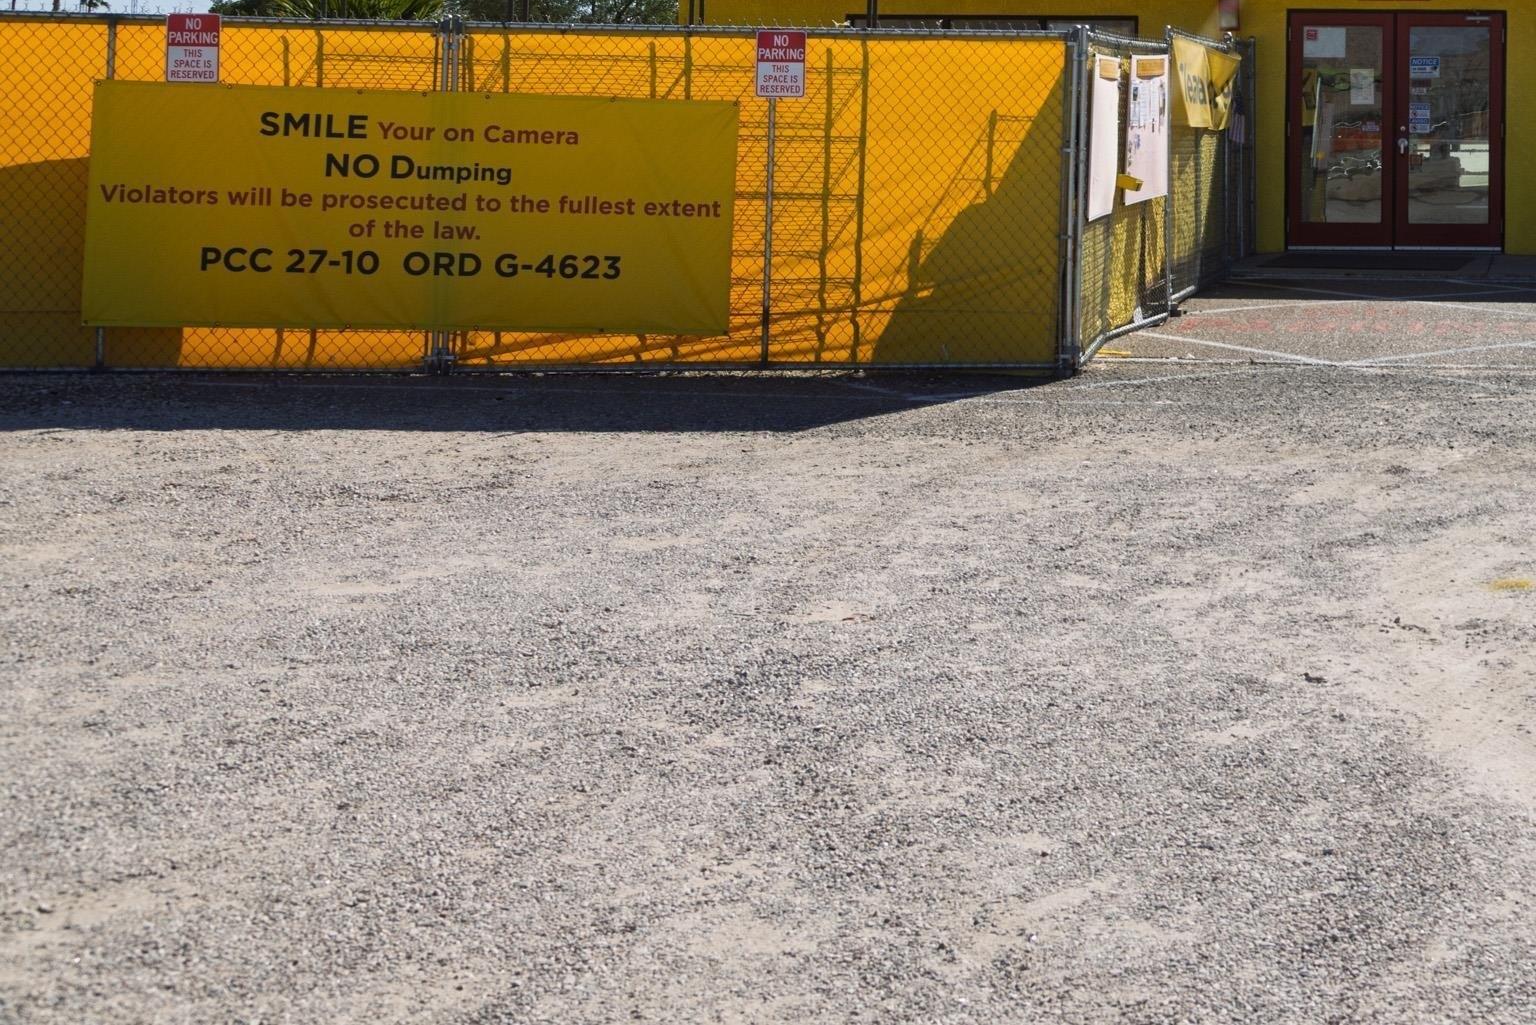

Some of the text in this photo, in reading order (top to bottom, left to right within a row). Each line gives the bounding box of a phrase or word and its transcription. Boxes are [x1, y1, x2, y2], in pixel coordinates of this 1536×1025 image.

[185, 18, 202, 30] NO
[168, 31, 219, 44] PARKING
[773, 35, 789, 47] NO
[184, 49, 203, 58] THIS
[758, 48, 804, 60] PARKING
[174, 60, 212, 69] SPACE IS
[772, 65, 790, 73] THIS
[170, 70, 215, 79] RESERVED
[763, 75, 798, 84] SPACE IS
[760, 85, 800, 94] RESERVED
[259, 112, 579, 145] SMILE Your on Camera
[325, 153, 512, 186] NO Dumping
[100, 184, 721, 218] Violators will be prosecuted to the fullest extent
[349, 219, 481, 240] of the law.
[200, 247, 622, 279] PCC 27-10 ORD G-4623
